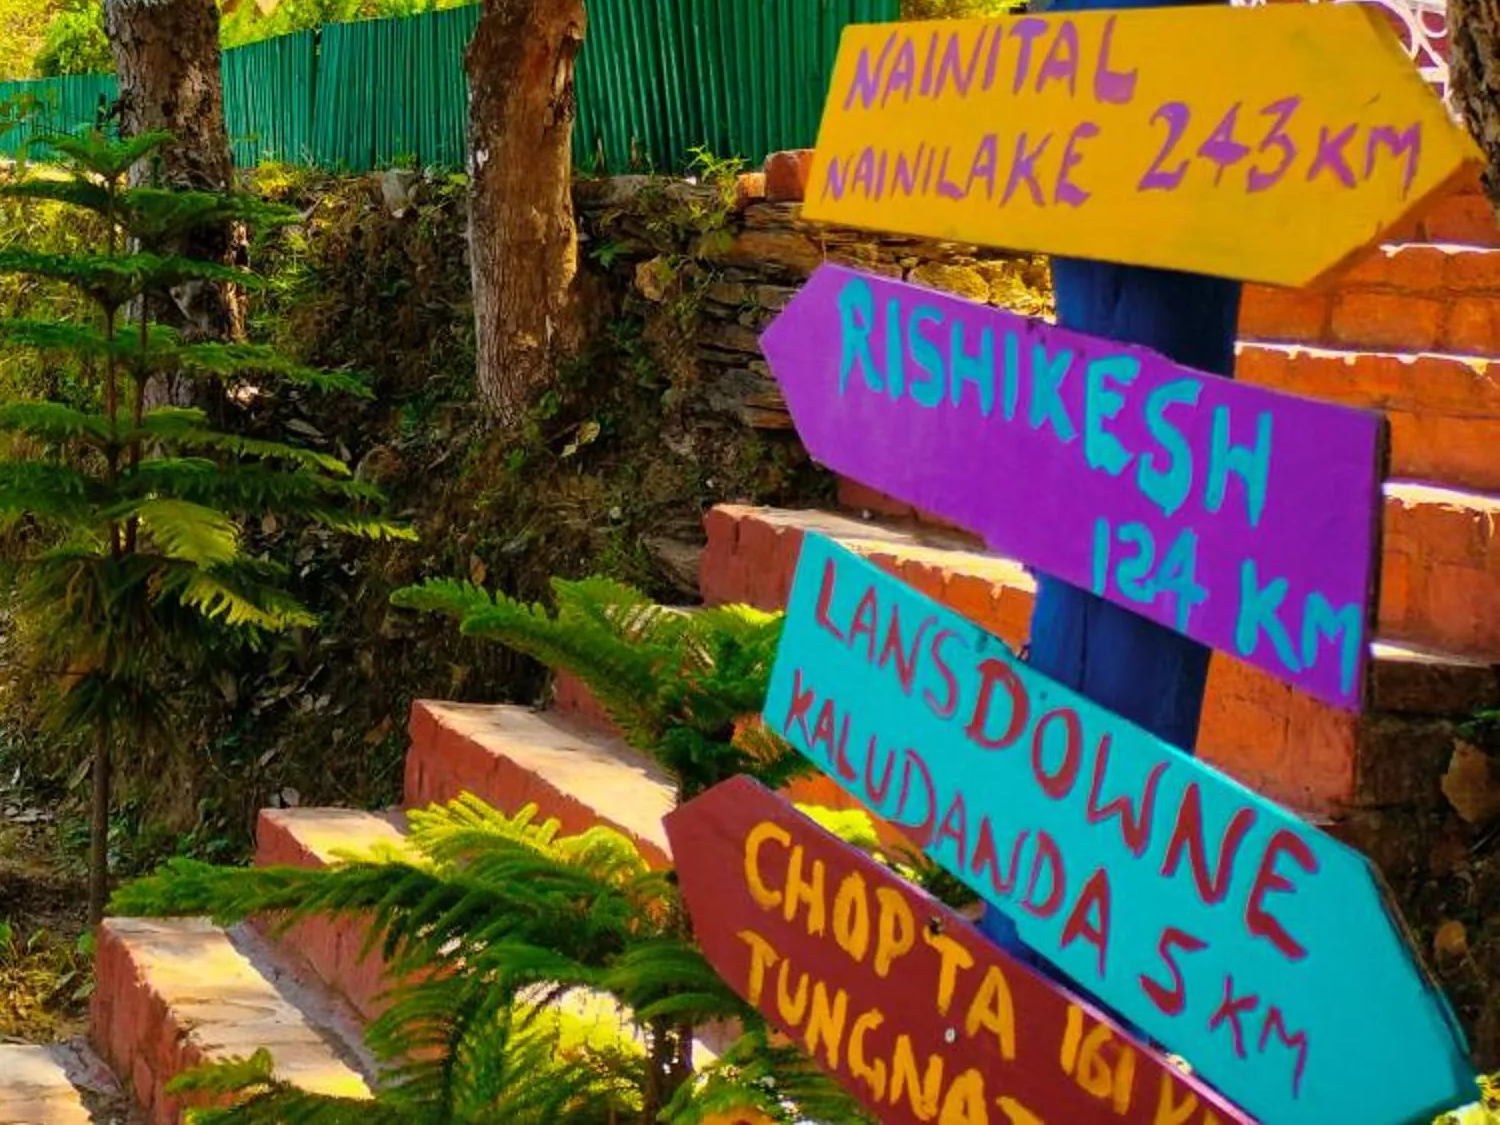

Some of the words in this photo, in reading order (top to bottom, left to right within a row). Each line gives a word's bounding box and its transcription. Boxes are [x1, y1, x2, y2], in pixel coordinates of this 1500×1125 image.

[820, 121, 1100, 208] NAINILAKE
[842, 15, 1139, 111] NAINITAL
[837, 276, 1272, 527] RISHIKESH
[1093, 517, 1210, 636] 124
[1237, 559, 1362, 697] KM
[814, 558, 1319, 961] LANSDOWNE
[744, 820, 1016, 1060] CHOPTA
[784, 669, 1112, 978] KALUDANDA
[1209, 974, 1310, 1100] KM
